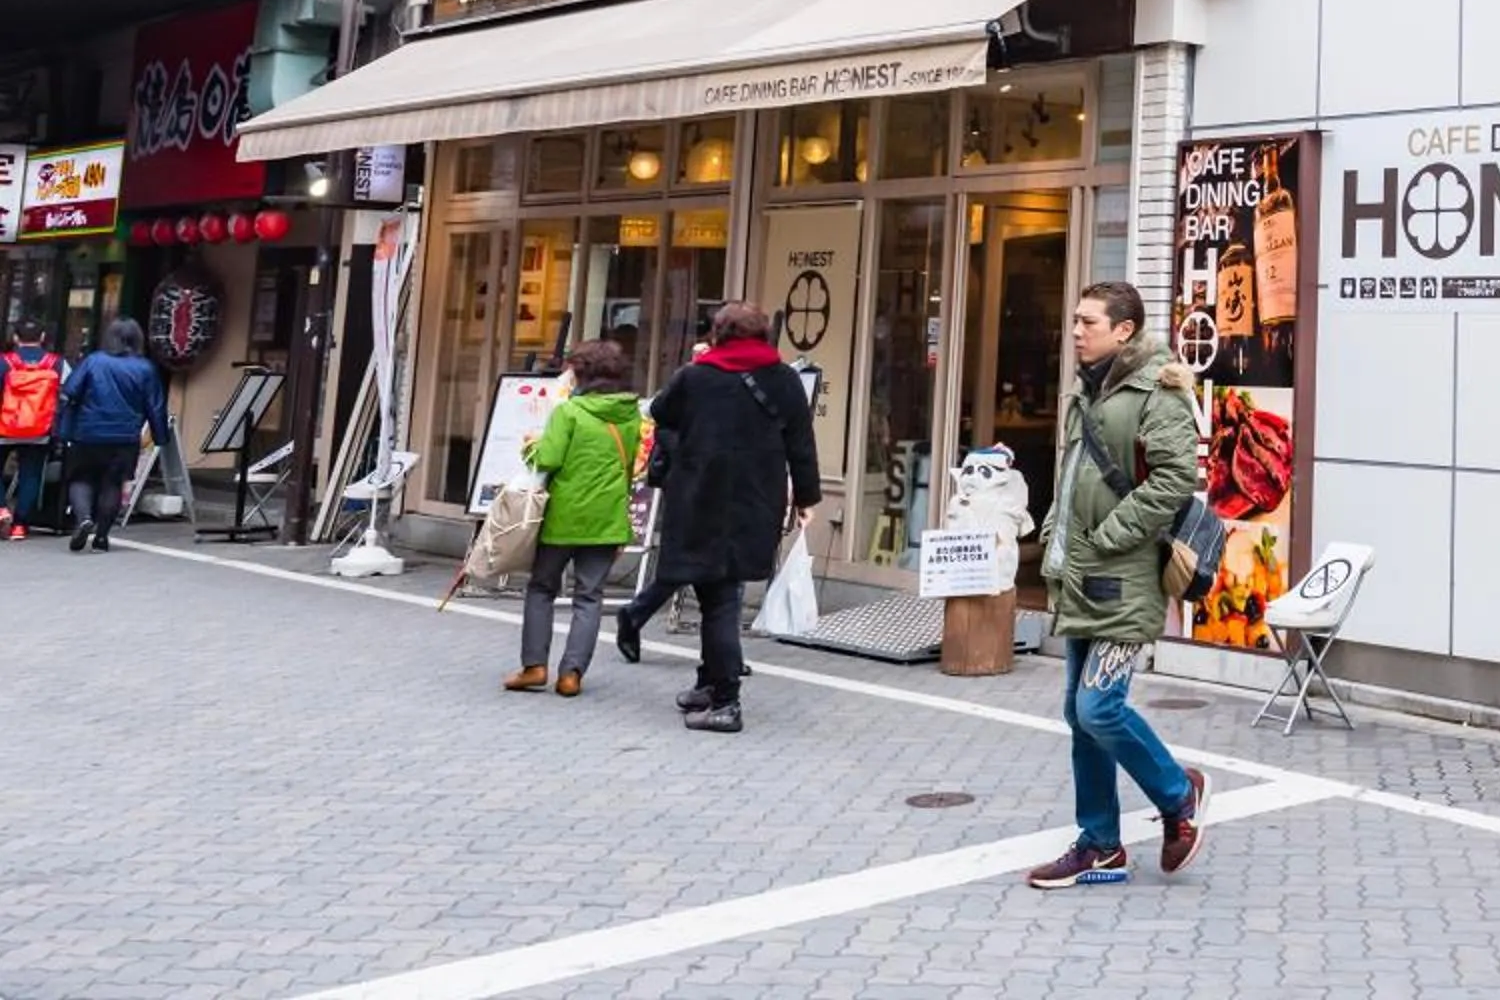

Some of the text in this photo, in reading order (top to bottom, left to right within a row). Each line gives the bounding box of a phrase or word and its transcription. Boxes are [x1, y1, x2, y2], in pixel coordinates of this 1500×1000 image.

[704, 85, 738, 105] CAFE
[738, 80, 788, 102] DINING
[789, 74, 819, 97] BAR
[823, 61, 903, 93] HONEST
[1408, 125, 1482, 157] CAFE
[1187, 147, 1246, 177] CAFE
[1185, 180, 1261, 209] DINING
[1184, 214, 1231, 241] BAR
